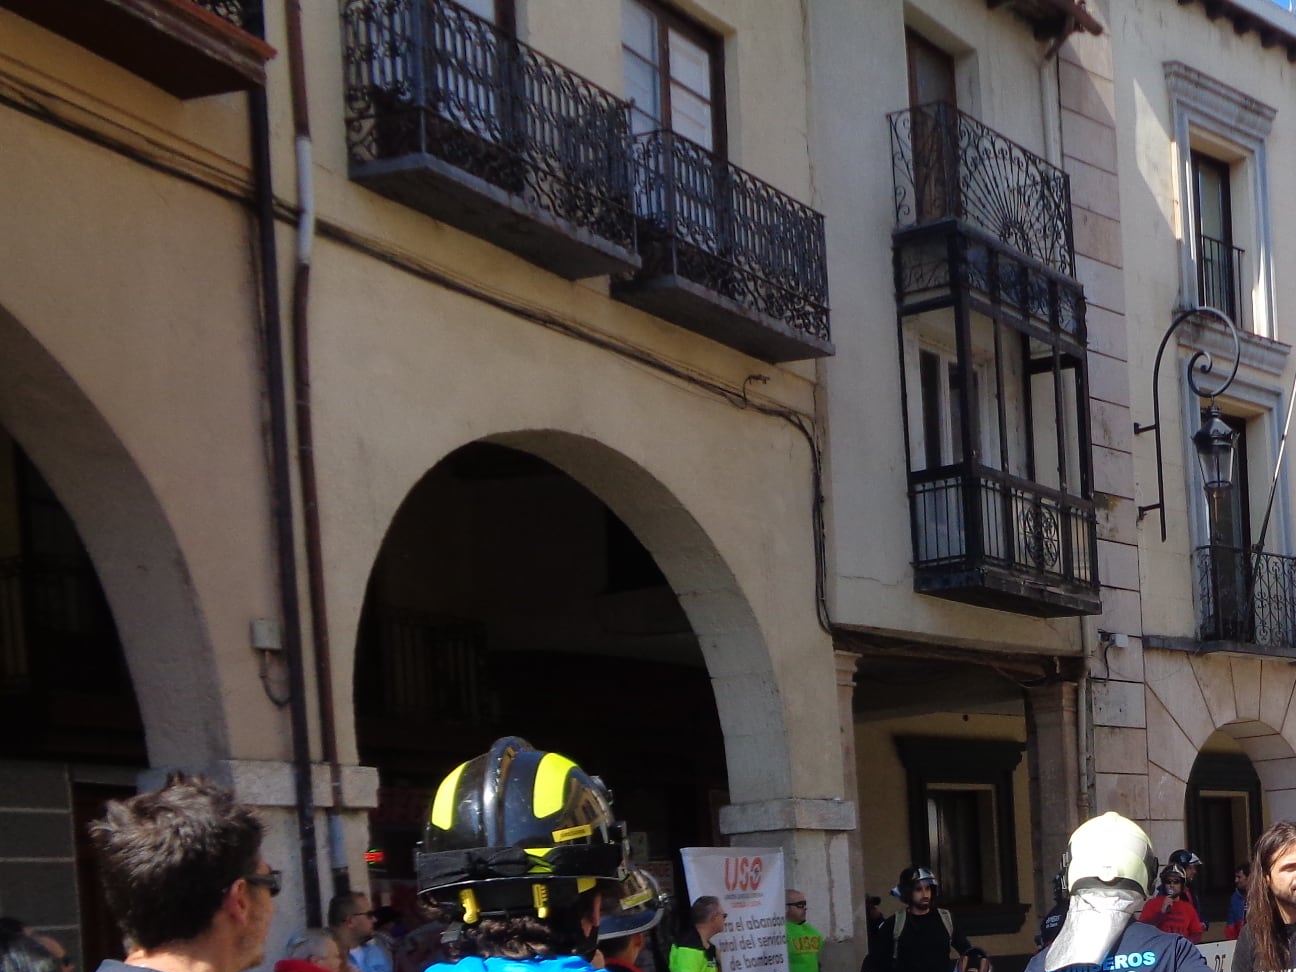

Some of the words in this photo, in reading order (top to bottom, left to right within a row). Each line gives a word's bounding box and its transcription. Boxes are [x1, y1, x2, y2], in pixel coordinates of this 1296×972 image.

[724, 856, 763, 891] USO
[740, 934, 755, 950] del
[730, 957, 742, 971] de
[744, 952, 784, 969] bomberos
